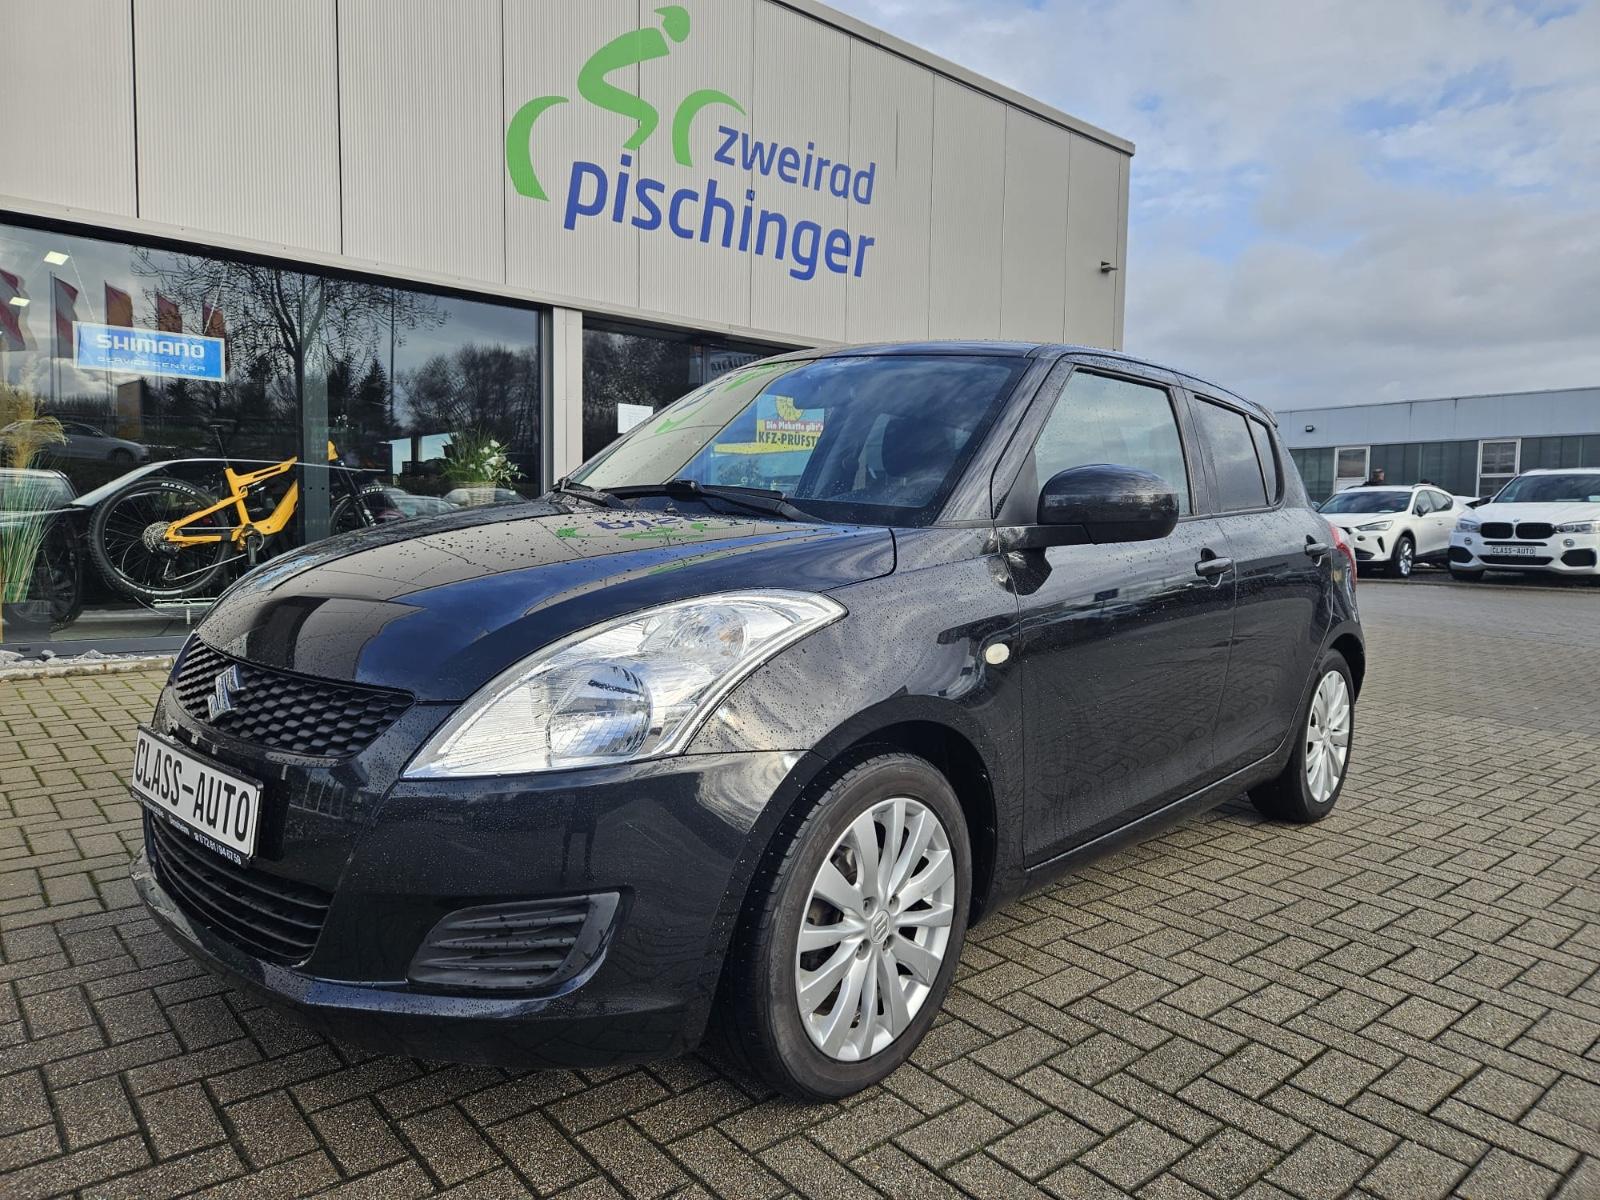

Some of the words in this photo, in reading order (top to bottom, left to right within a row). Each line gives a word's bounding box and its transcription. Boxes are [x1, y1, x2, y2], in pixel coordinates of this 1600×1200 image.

[713, 125, 876, 205] zweirad
[563, 153, 875, 281] pischinger
[96, 334, 205, 359] SHIMANO
[758, 431, 819, 448] KFZ-PRÜFST
[135, 738, 250, 842] CLASS-AUTO
